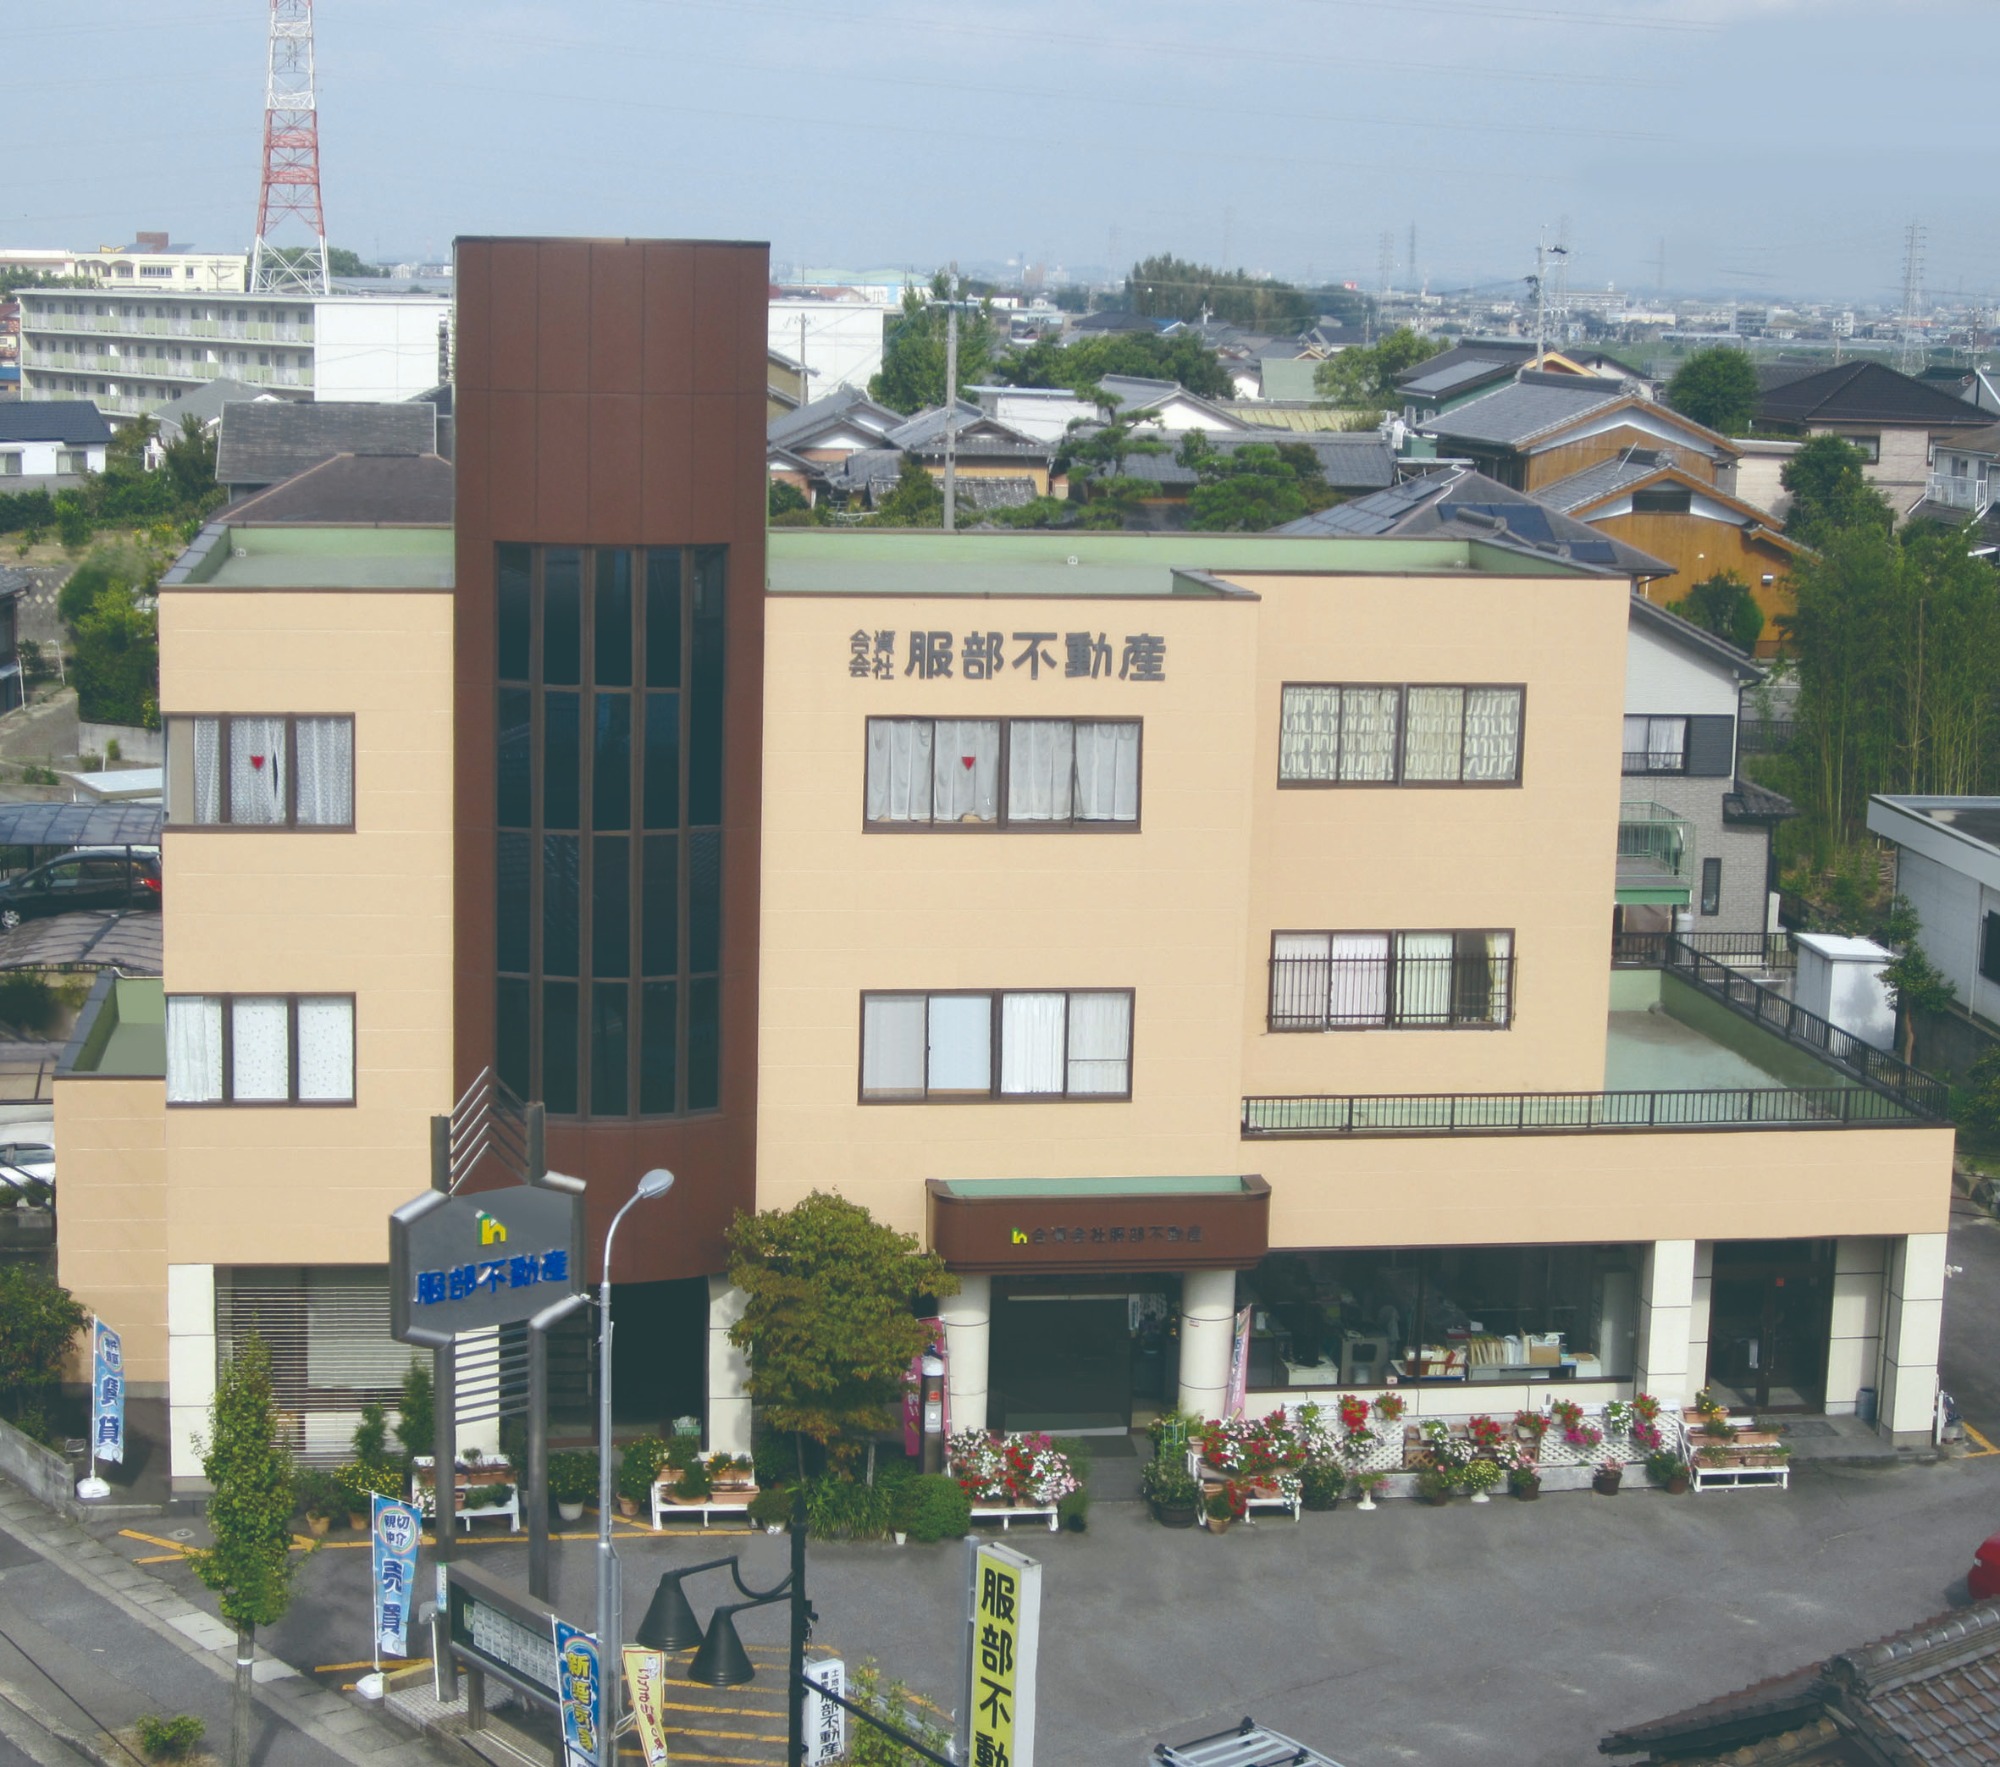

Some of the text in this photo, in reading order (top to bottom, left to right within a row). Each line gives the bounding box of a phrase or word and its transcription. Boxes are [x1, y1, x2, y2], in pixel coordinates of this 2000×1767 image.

[850, 629, 896, 655] 合資
[904, 630, 1167, 681] 服部不動産
[848, 653, 895, 680] 会社
[414, 1249, 569, 1305] 服部不動産
[384, 1514, 410, 1529] 親切
[386, 1531, 407, 1546] 仲介
[974, 1567, 1015, 1767] 服部不動
